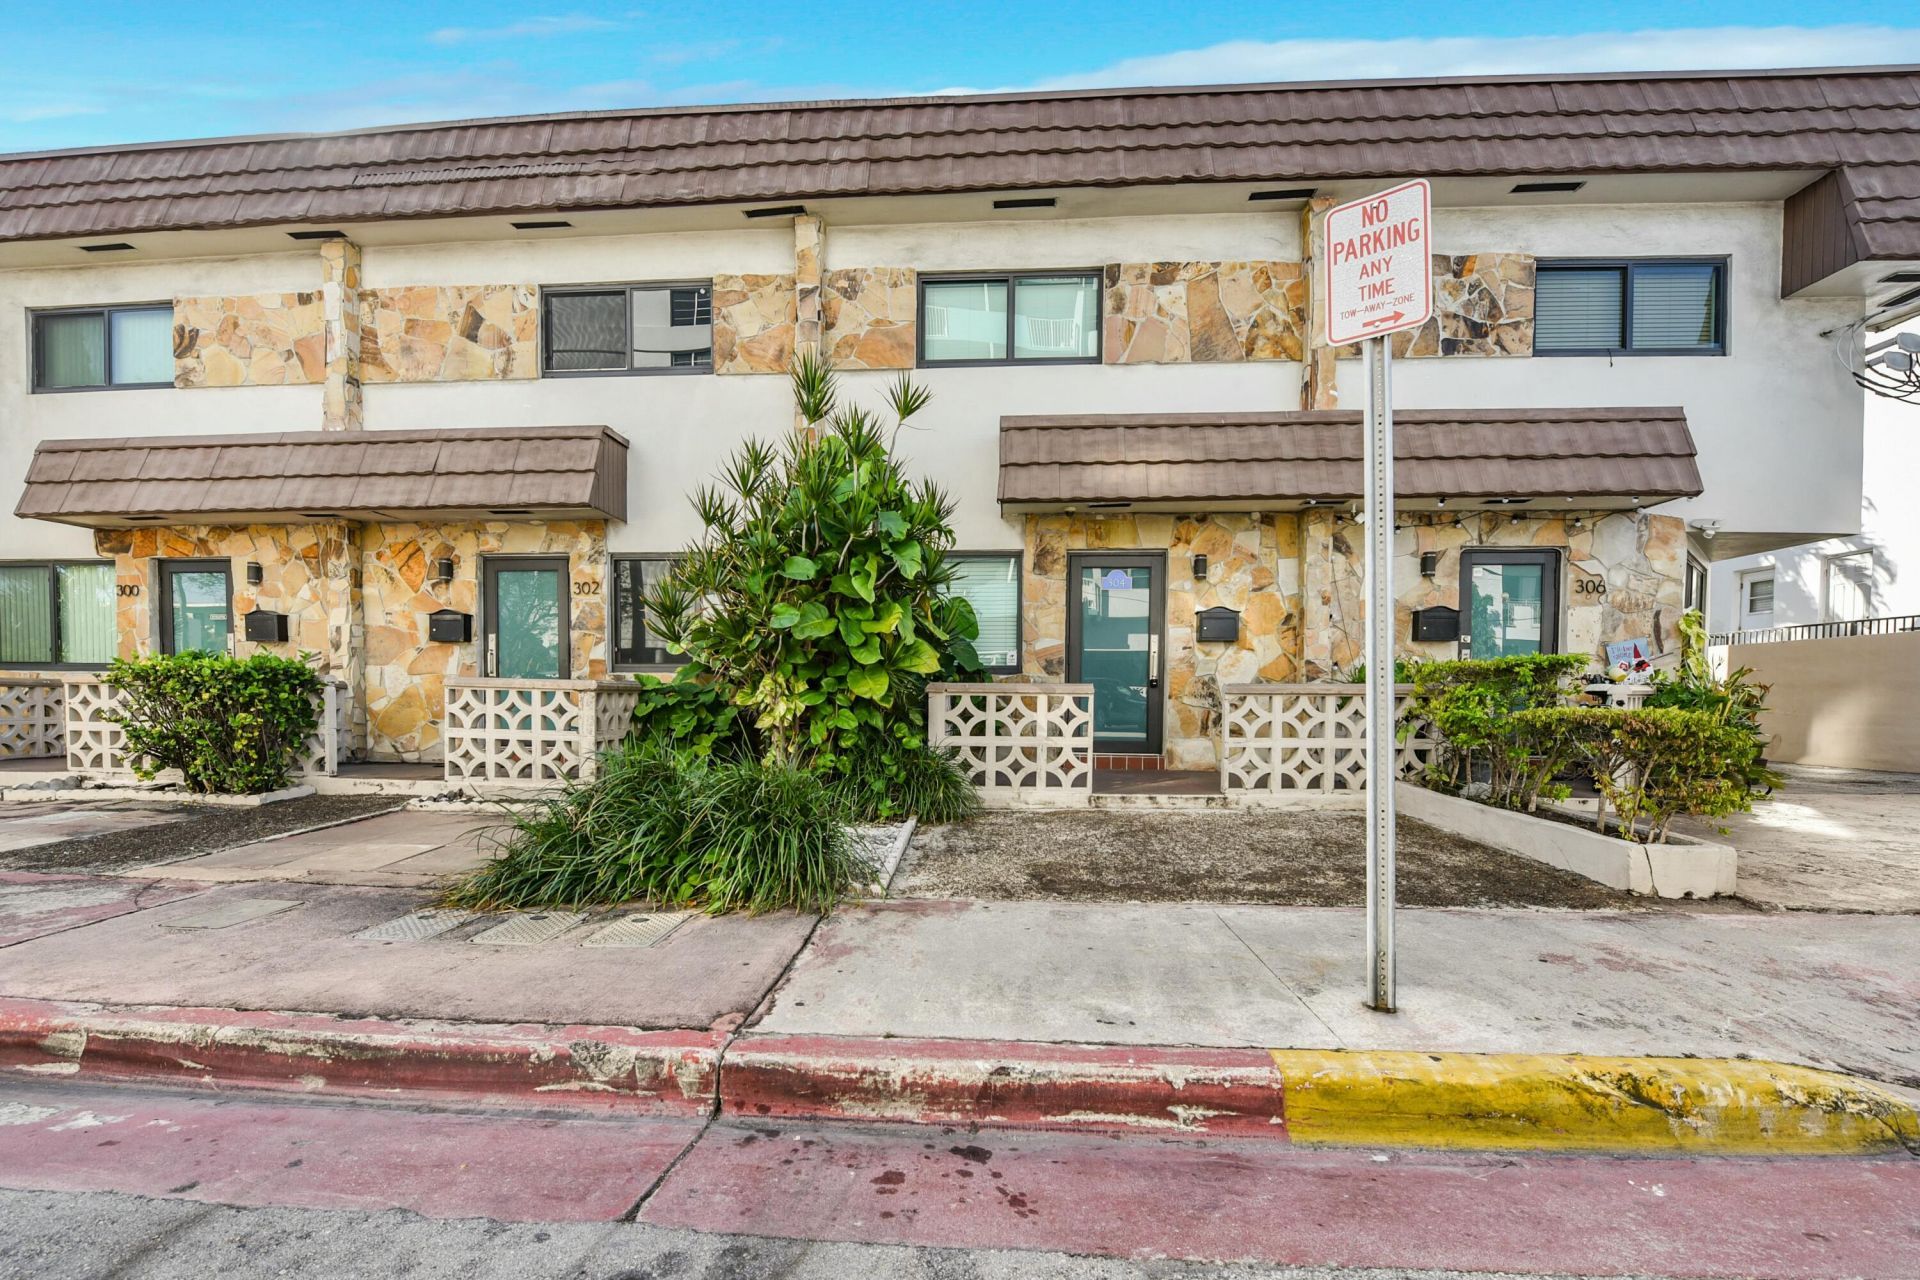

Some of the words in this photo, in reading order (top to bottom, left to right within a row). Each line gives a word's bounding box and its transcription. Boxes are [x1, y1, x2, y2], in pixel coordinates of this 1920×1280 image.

[1362, 199, 1389, 228] NO
[1333, 217, 1420, 265] PARKING
[1359, 256, 1393, 280] ANY
[1358, 277, 1395, 301] TIME
[116, 584, 140, 597] 300
[573, 581, 600, 595] 302
[1575, 579, 1607, 594] 306
